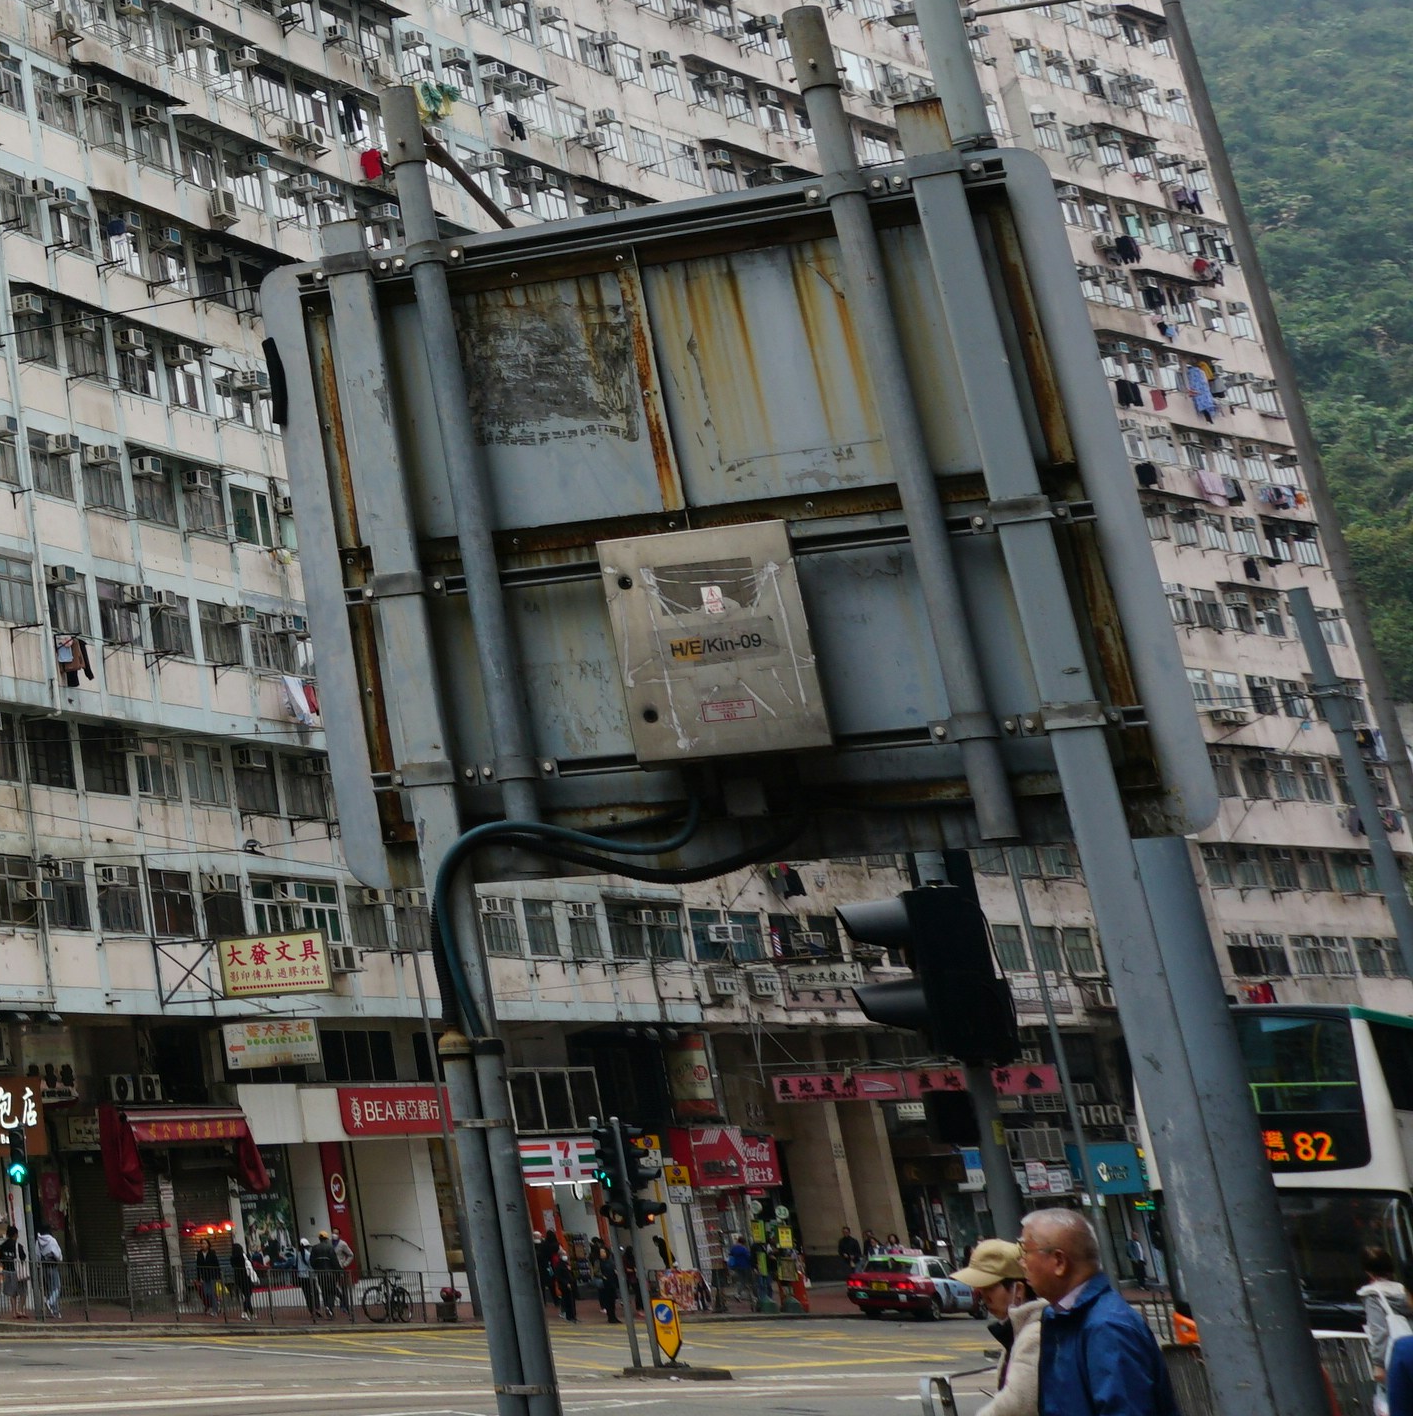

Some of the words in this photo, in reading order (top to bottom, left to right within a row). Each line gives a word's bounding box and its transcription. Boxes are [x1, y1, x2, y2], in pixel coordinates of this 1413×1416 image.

[670, 633, 763, 657] H/E/Kin-09
[227, 939, 320, 966] 大發文具
[230, 968, 274, 983] 影印傳真
[1292, 1131, 1338, 1162] 82
